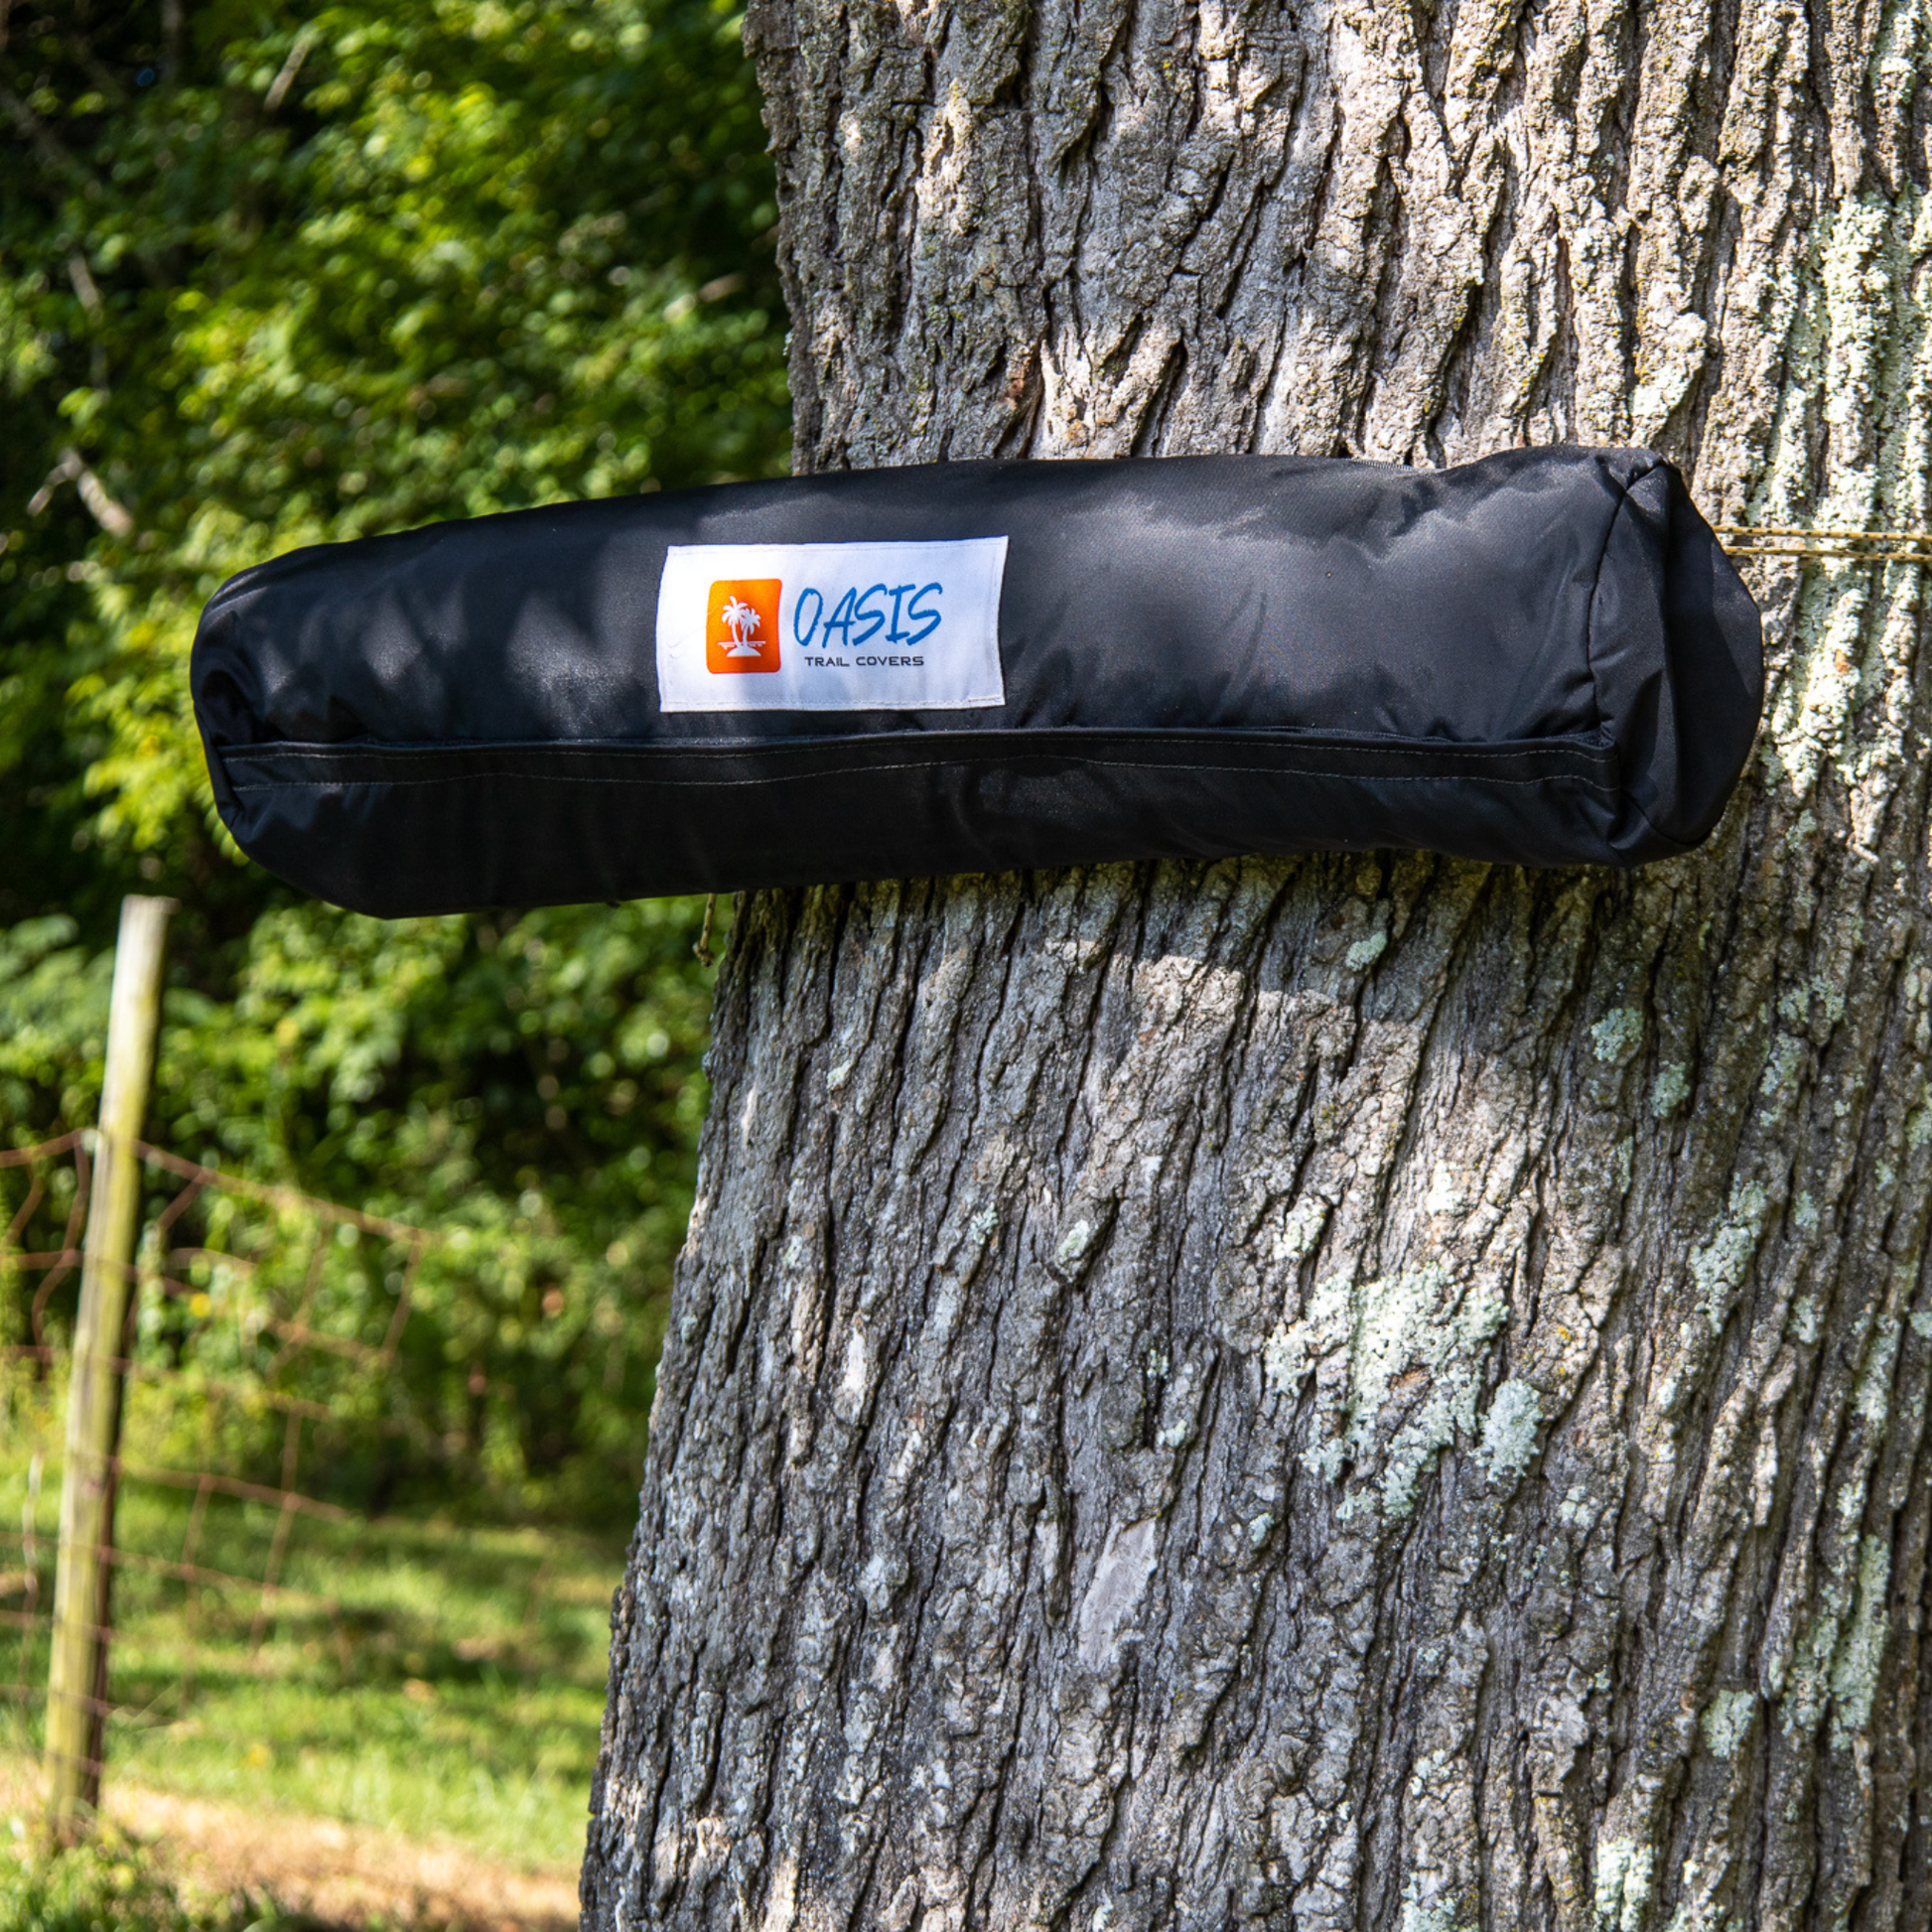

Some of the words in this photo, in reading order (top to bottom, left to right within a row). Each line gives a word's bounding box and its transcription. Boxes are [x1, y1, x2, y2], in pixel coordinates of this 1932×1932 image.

[793, 582, 943, 649] OASIS
[804, 655, 850, 667] TRAIL
[855, 655, 924, 667] COVERS
